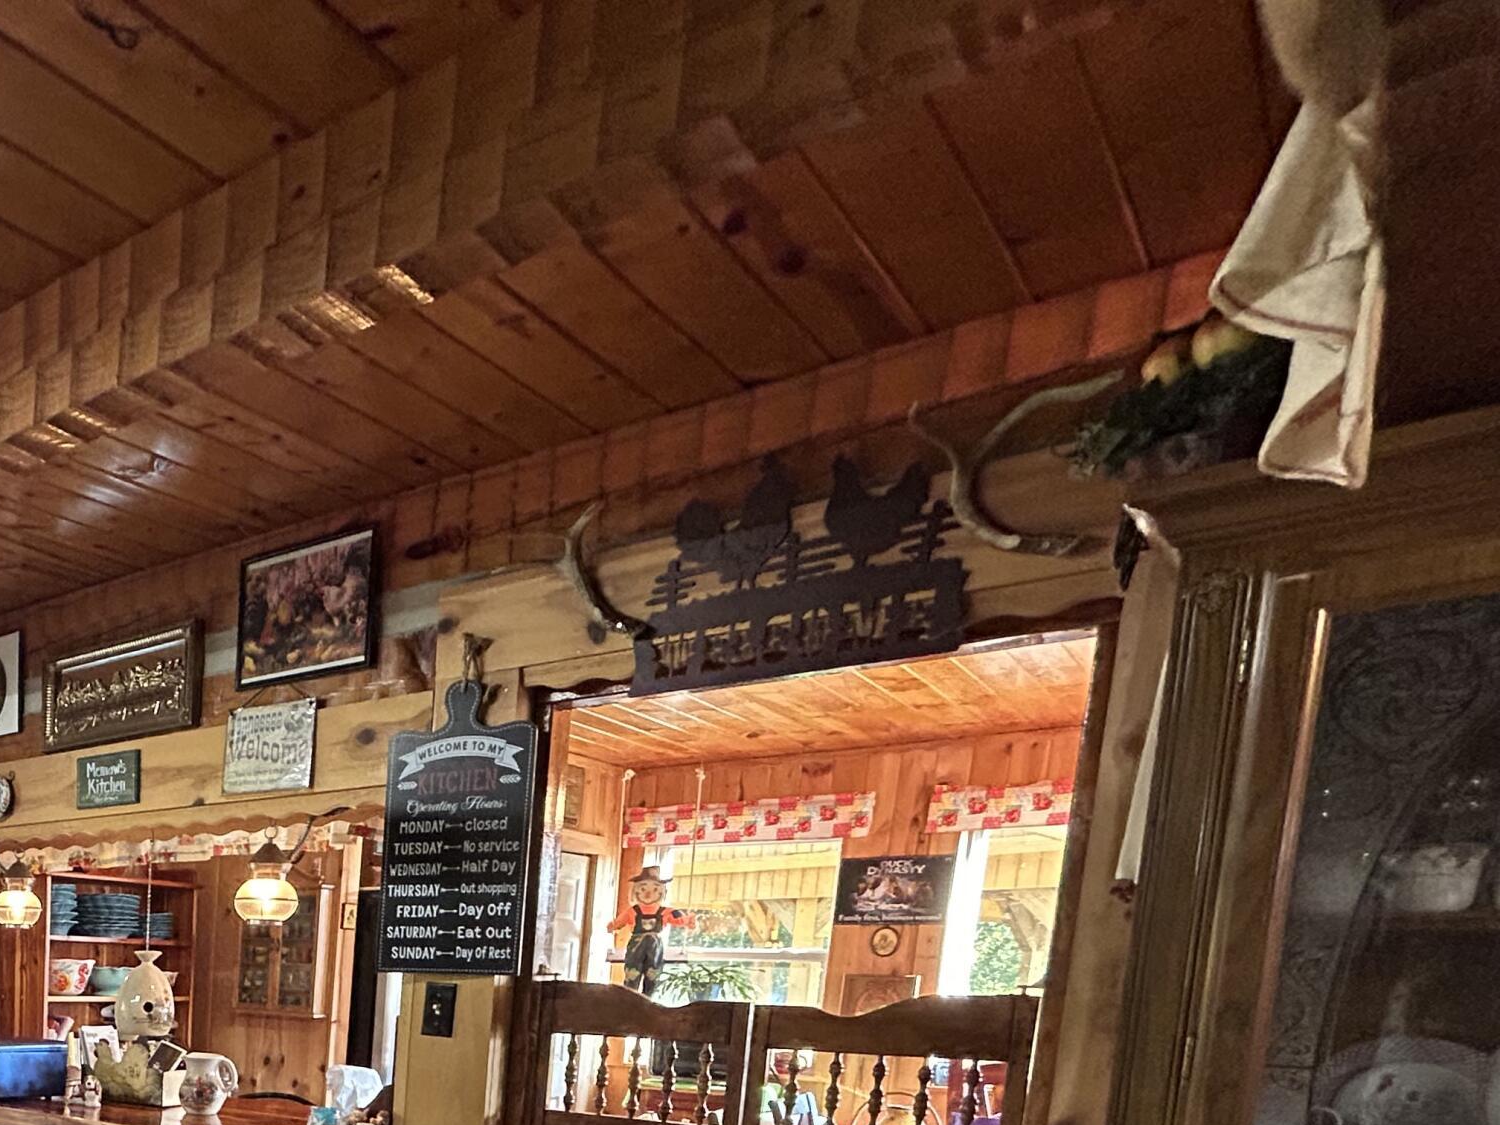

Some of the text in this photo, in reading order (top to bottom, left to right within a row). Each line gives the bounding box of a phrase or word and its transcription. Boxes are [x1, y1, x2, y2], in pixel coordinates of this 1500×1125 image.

[417, 740, 506, 761] WELCOME TO MY
[85, 776, 126, 799] Kitchen
[417, 767, 498, 795] KITCHEN
[406, 799, 459, 817] Operating
[399, 816, 508, 834] MONDAY closed
[393, 839, 520, 855] TUESDAY No service
[389, 860, 517, 877] WEDNESDAY Half Day
[387, 883, 518, 897] THURSDAY Out shopping
[396, 902, 512, 919] FRIDAY Day Off
[386, 925, 512, 939] SATURDAY Eat Out
[391, 946, 511, 962] SUNDAY Day Of Rest
